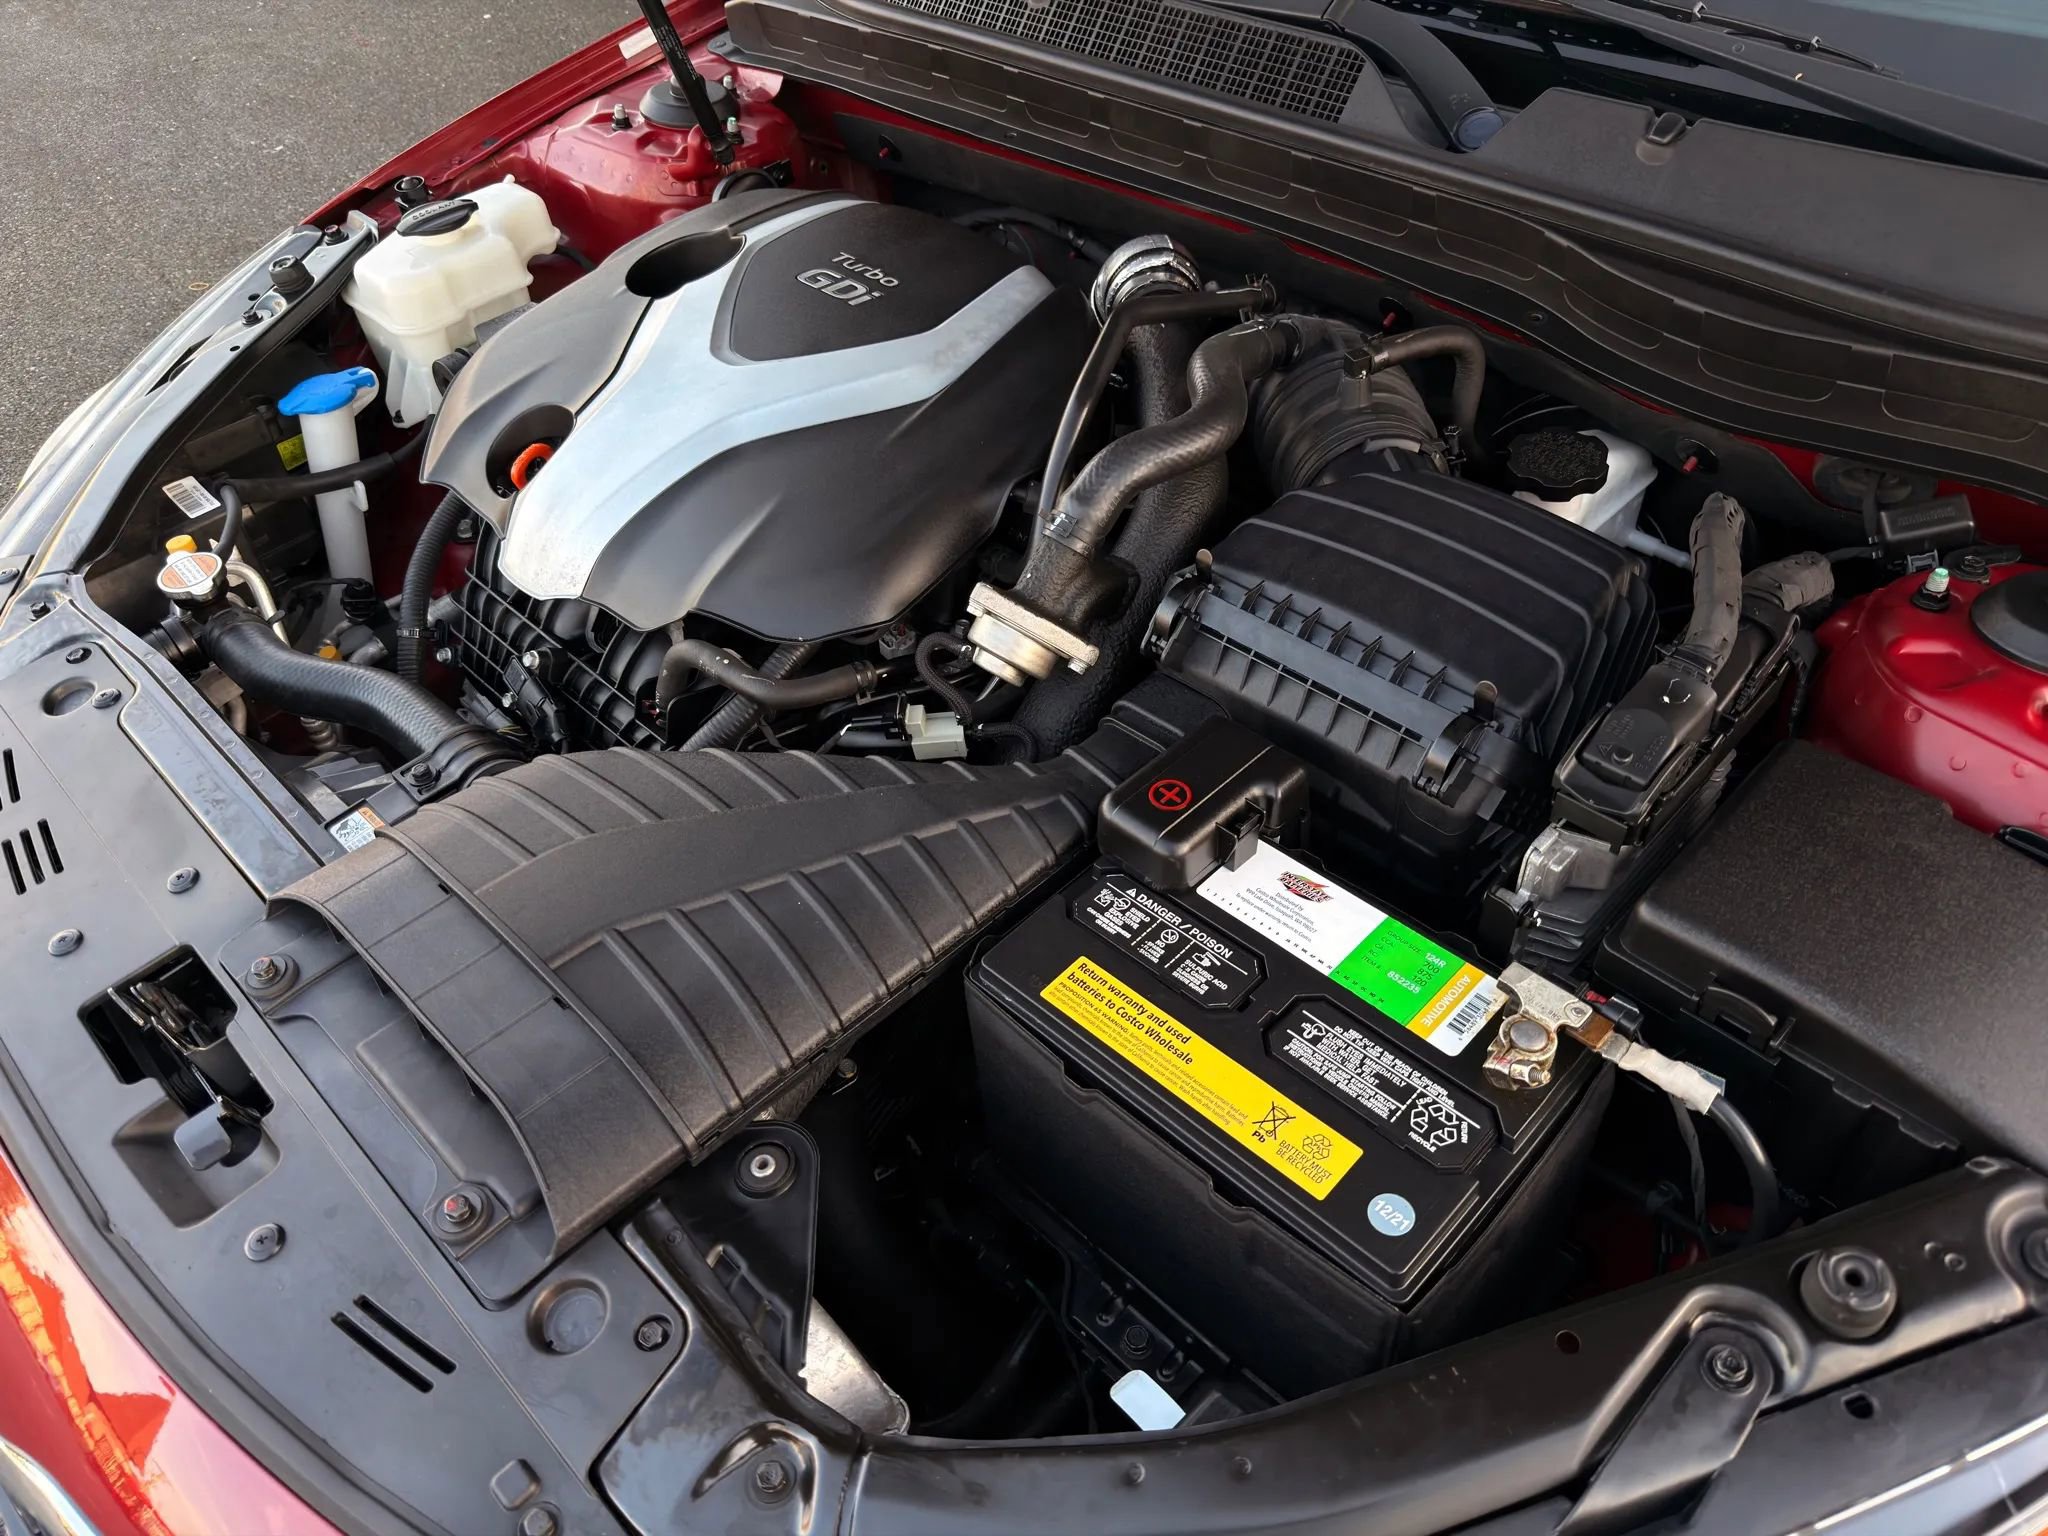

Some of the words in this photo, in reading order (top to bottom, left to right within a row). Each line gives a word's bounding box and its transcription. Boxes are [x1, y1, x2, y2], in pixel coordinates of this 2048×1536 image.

[831, 251, 899, 287] Turbo
[796, 268, 884, 306] GDi
[1253, 892, 1265, 901] Lake
[1276, 874, 1324, 904] BATTERIES
[1281, 869, 1332, 902] INTERSTATE
[1103, 911, 1124, 926] GASES
[1107, 907, 1140, 929] EXPLOSIVE
[1124, 910, 1141, 923] EYES
[1128, 906, 1151, 922] SHIELD
[1135, 892, 1183, 926] DANGER
[1187, 926, 1234, 959] POISON
[1154, 939, 1166, 948] NO
[1423, 951, 1447, 968] 124R
[1182, 958, 1215, 980] SULFURIC
[1210, 978, 1229, 990] ACID
[1385, 969, 1421, 994] 852235
[1411, 974, 1428, 987] 120
[1415, 967, 1433, 981] 875
[1422, 961, 1440, 974] 700
[1058, 981, 1095, 1008] PROPOSITION
[1078, 963, 1107, 986] Return
[1108, 984, 1148, 1015] warranty
[1147, 1013, 1168, 1027] and
[1166, 1025, 1191, 1044] used
[1419, 974, 1473, 1027] AUTOMOTIVE
[1067, 972, 1105, 1002] batteries
[1105, 999, 1115, 1009] to
[1116, 1007, 1144, 1030] Costco
[1145, 1026, 1192, 1064] Wholesale
[1287, 1041, 1322, 1067] INSTRUCTIONS
[1326, 1068, 1349, 1085] VEHICLE
[1315, 1041, 1345, 1063] MEDICAL
[1342, 1060, 1362, 1075] HELP
[1359, 1071, 1379, 1086] FAST
[1320, 1037, 1339, 1051] WITH
[1360, 1063, 1377, 1076] GET
[1324, 1031, 1347, 1049] FLUSH
[1345, 1045, 1364, 1060] EYES
[1362, 1056, 1407, 1088] IMMEDIATELY
[1333, 1025, 1344, 1034] DO
[1341, 1031, 1355, 1041] NOT
[1364, 1046, 1380, 1058] KEEP
[1378, 1055, 1395, 1067] VENT
[1393, 1064, 1410, 1077] CAPS
[1407, 1074, 1427, 1088] TIGHT
[1424, 1085, 1440, 1096] AND
[1436, 1093, 1457, 1107] LEVEL
[1347, 1028, 1363, 1040] KEEP
[1361, 1037, 1375, 1047] OUT
[1372, 1044, 1383, 1053] OF
[1380, 1050, 1395, 1061] THE
[1392, 1057, 1413, 1073] REACH
[1410, 1069, 1422, 1078] OF
[1419, 1075, 1449, 1096] CHILDREN
[1287, 1048, 1301, 1059] NOT
[1298, 1055, 1325, 1076] AVAILABLE
[1322, 1072, 1338, 1085] SEEK
[1335, 1081, 1358, 1098] SERVICE
[1312, 1052, 1325, 1062] FOR
[1322, 1059, 1337, 1070] SAFE
[1335, 1067, 1352, 1080] JUMP
[1349, 1077, 1376, 1096] STARTING
[1373, 1093, 1397, 1110] FOLLOW
[1251, 1129, 1267, 1143] Pb
[1406, 1130, 1438, 1153] RECYCLE
[1275, 1147, 1288, 1159] BE
[1285, 1154, 1324, 1185] RECYCLED
[1278, 1139, 1312, 1165] BATTERY
[1308, 1160, 1333, 1180] MUST
[1375, 1200, 1410, 1231] 12/21
